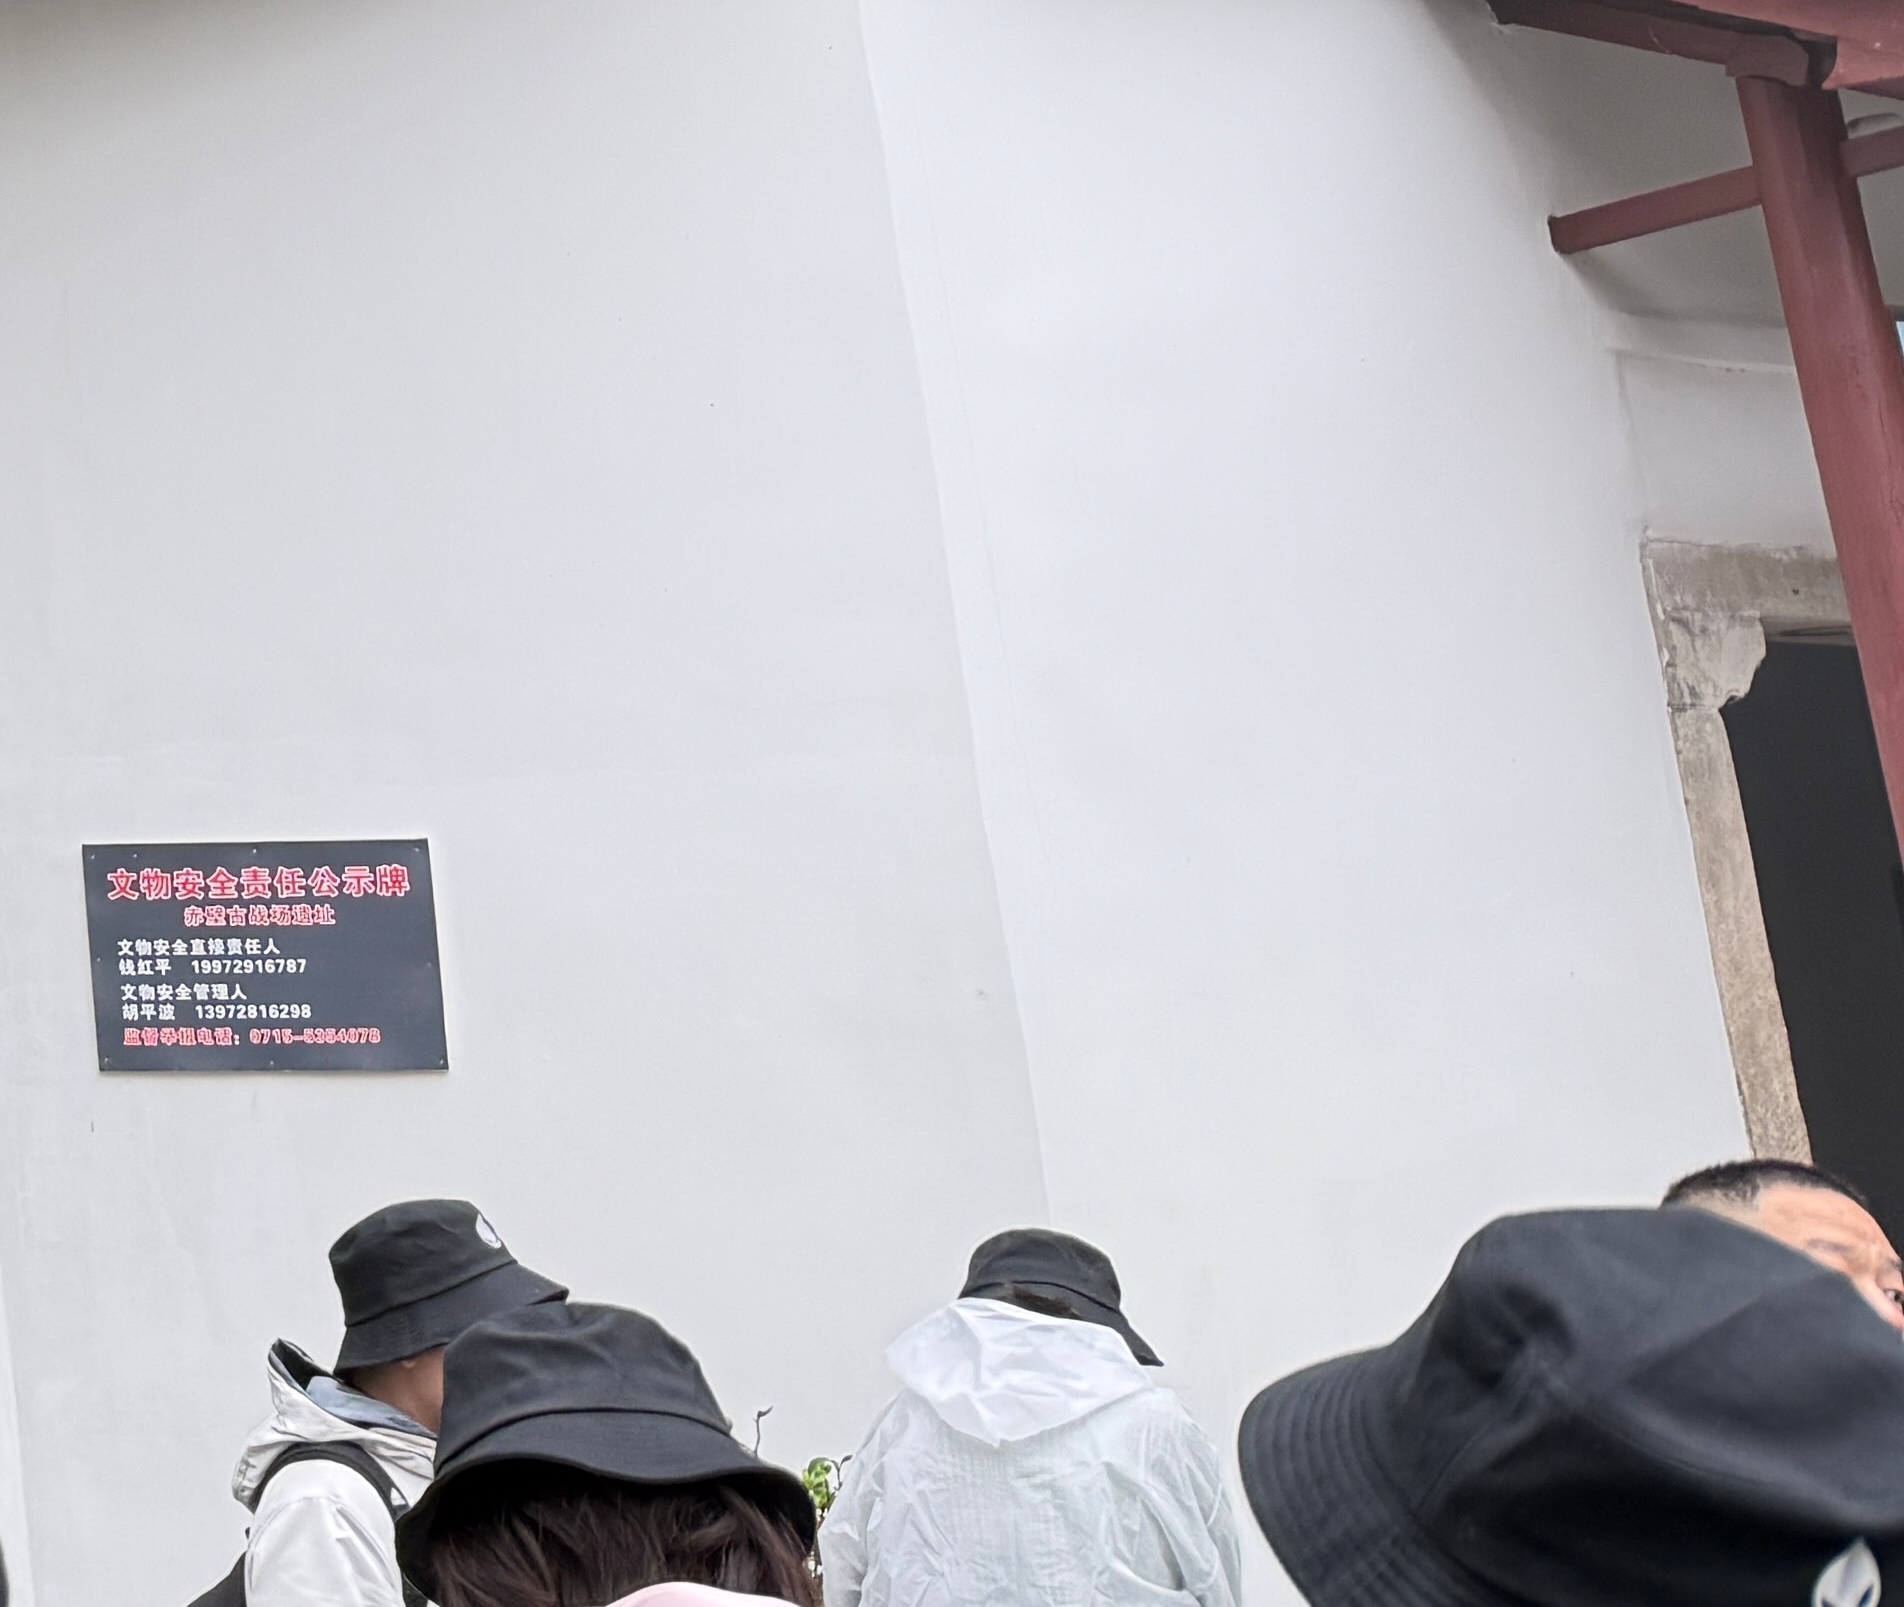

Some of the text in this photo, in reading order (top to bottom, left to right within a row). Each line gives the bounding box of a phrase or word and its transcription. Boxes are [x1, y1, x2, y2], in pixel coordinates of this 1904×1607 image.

[107, 864, 410, 900] 文物安全责任公示牌
[184, 905, 336, 926] 赤壁古战场遗址
[117, 938, 280, 957] 文物安全直接责任人
[192, 959, 306, 974] 19972916787
[121, 983, 247, 1001] 文物安全管理人
[195, 1005, 311, 1019] 13972816298
